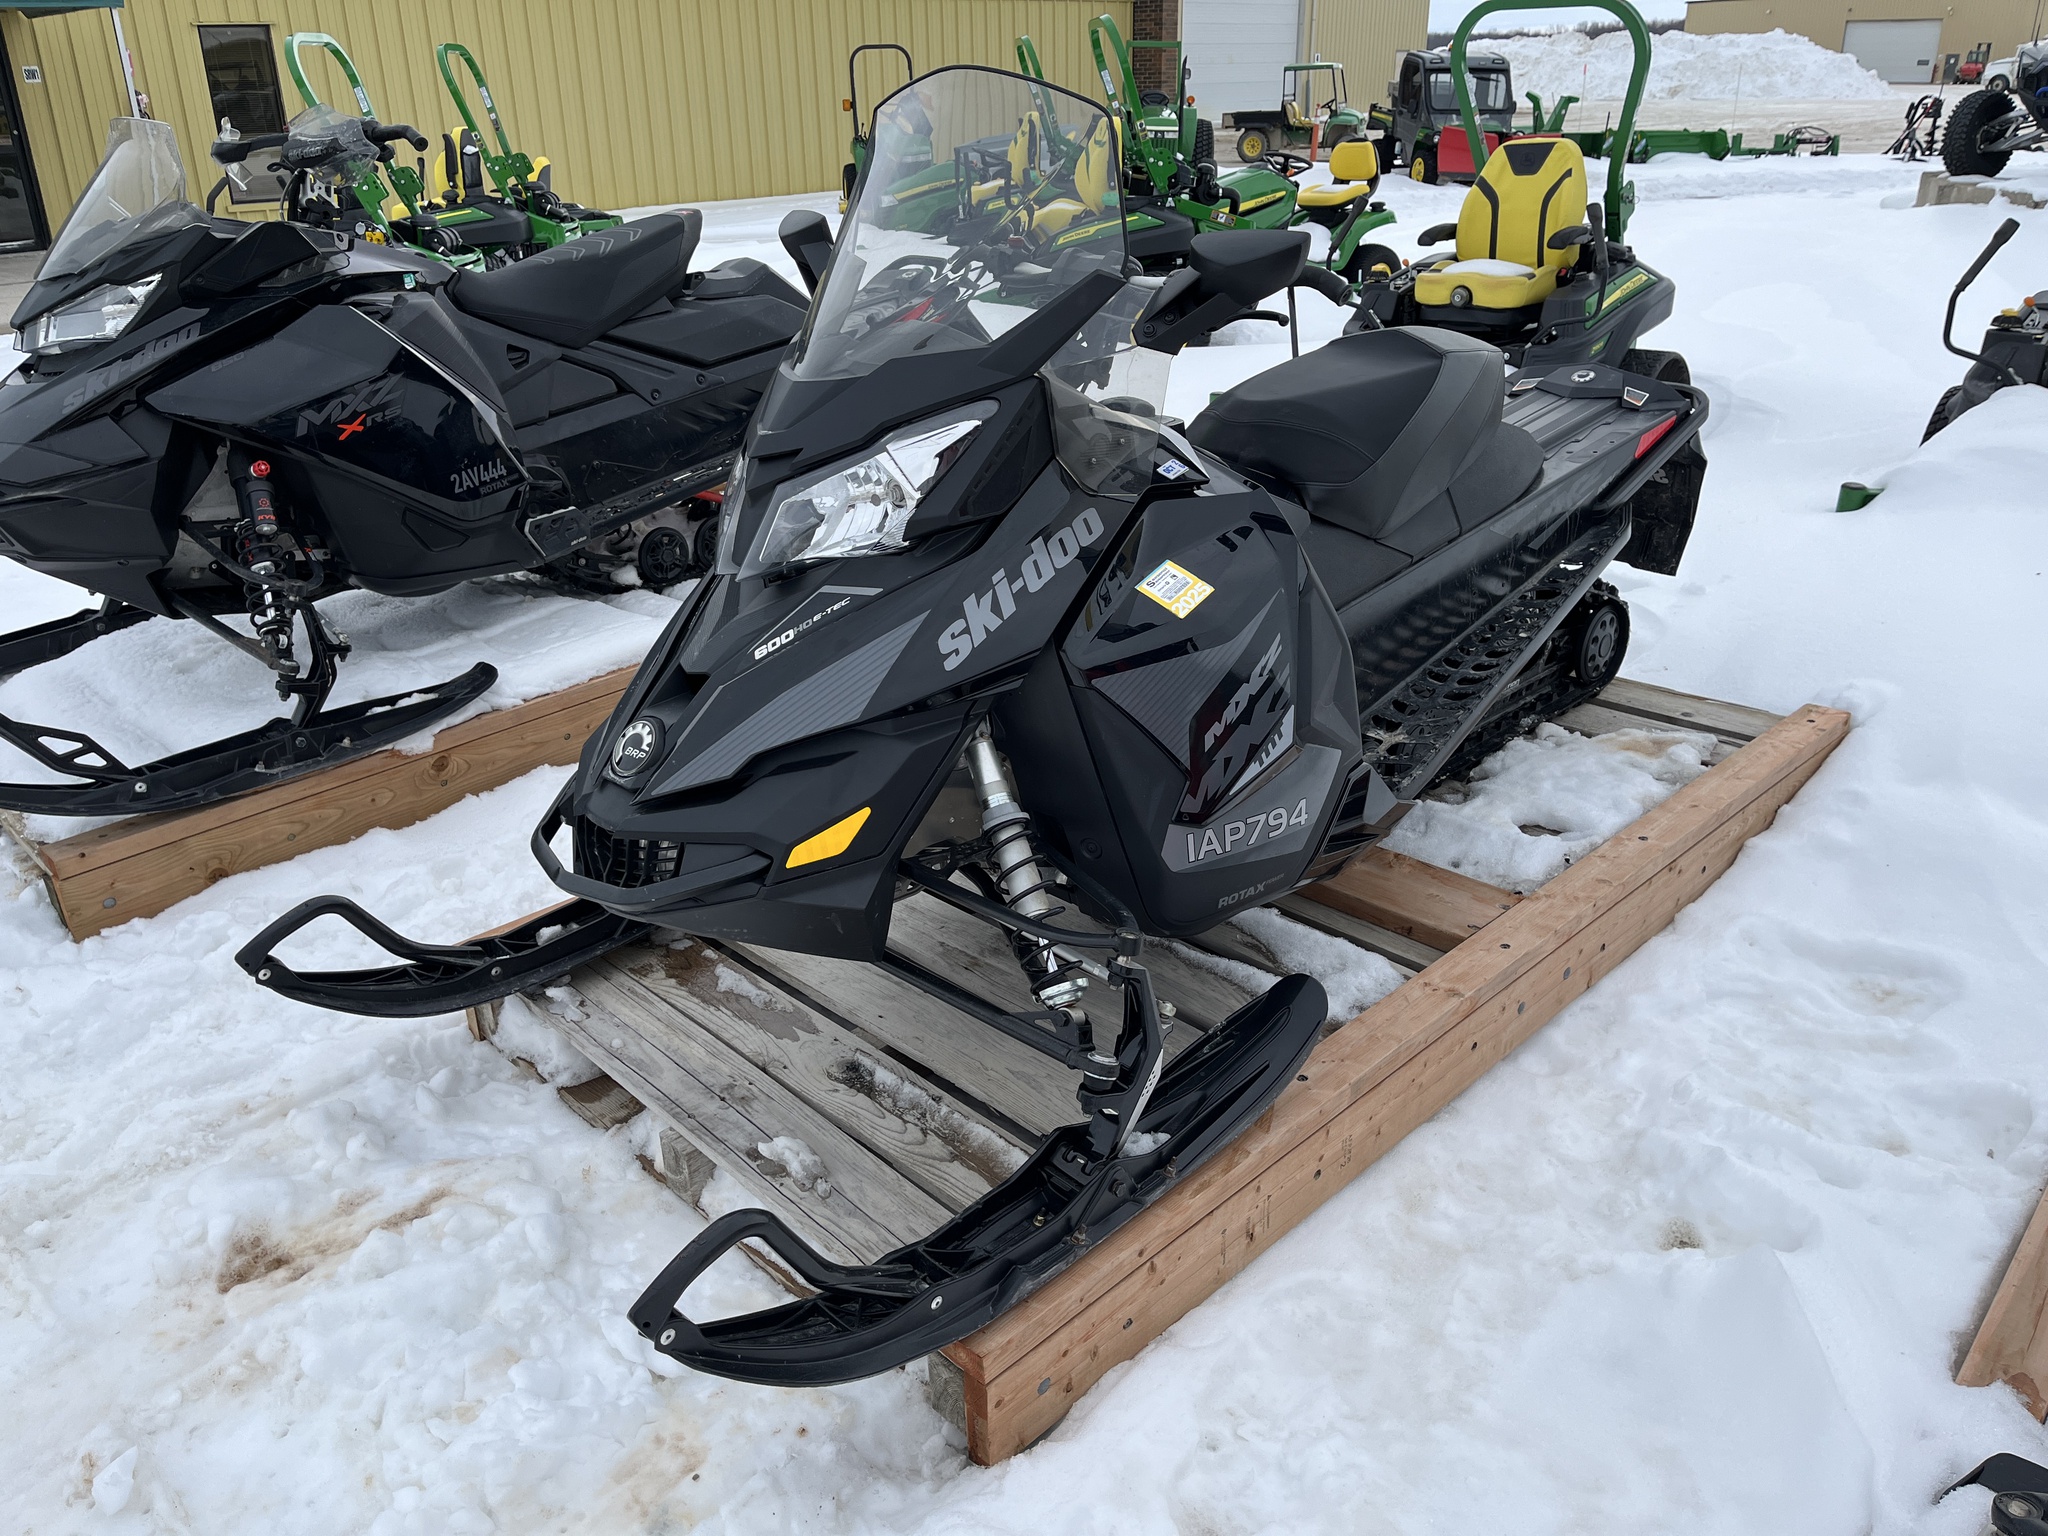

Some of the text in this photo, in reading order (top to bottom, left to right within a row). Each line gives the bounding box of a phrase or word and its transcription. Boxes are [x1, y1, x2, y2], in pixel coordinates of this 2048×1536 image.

[450, 458, 507, 493] 2AV444
[480, 479, 509, 495] ROTAX
[937, 507, 1105, 672] ski-doo
[1171, 582, 1211, 618] 2025
[812, 596, 851, 622] E-TEC
[624, 746, 647, 759] BRP
[1217, 879, 1269, 909] ROTAX
